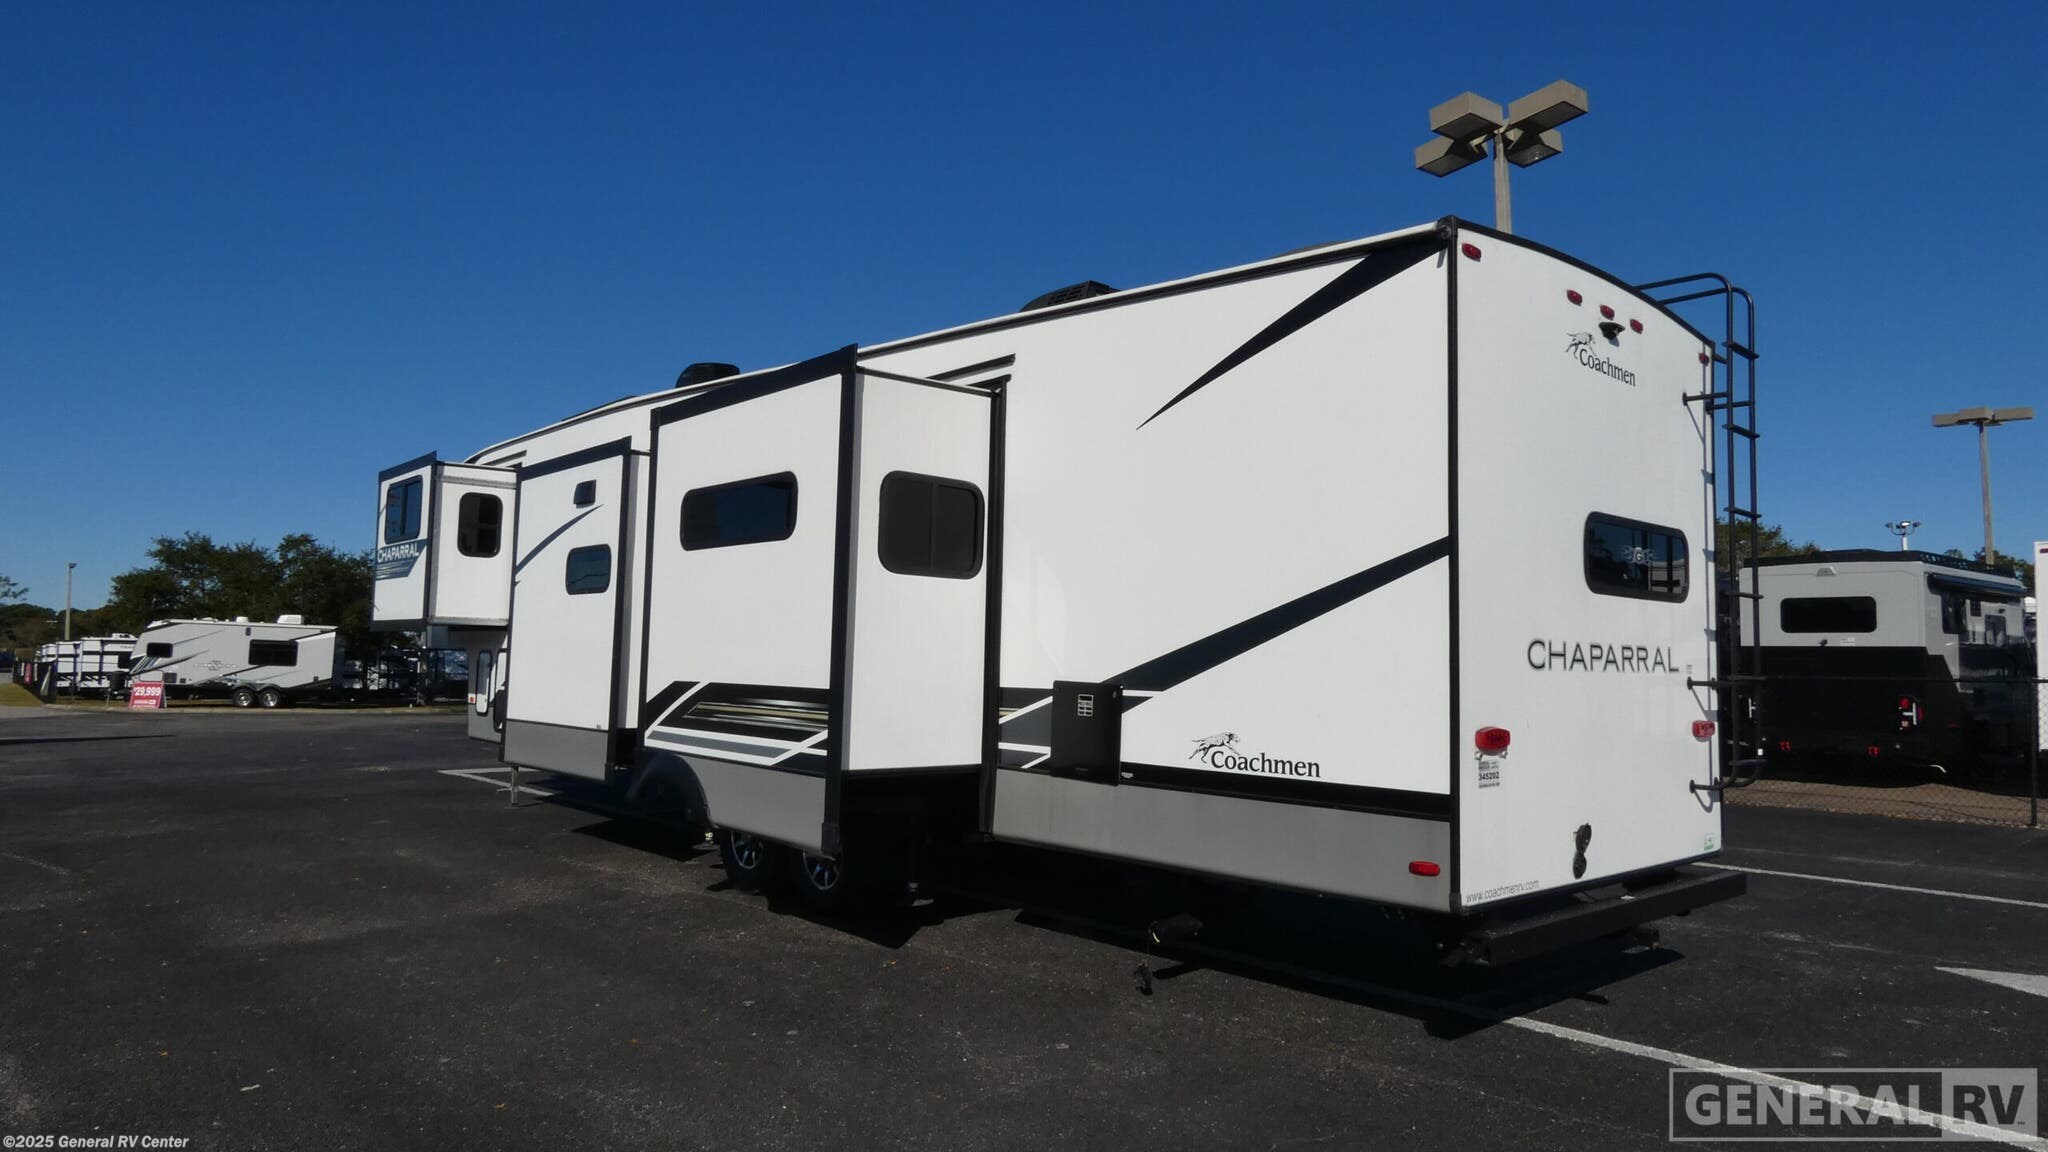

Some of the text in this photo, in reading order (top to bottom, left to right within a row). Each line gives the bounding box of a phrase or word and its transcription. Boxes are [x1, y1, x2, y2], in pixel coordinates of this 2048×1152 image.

[1579, 348, 1636, 387] Coachmen
[377, 543, 420, 563] CHAPARRAL
[1527, 639, 1680, 673] CHAPARRAL
[1210, 750, 1321, 778] Coachmen
